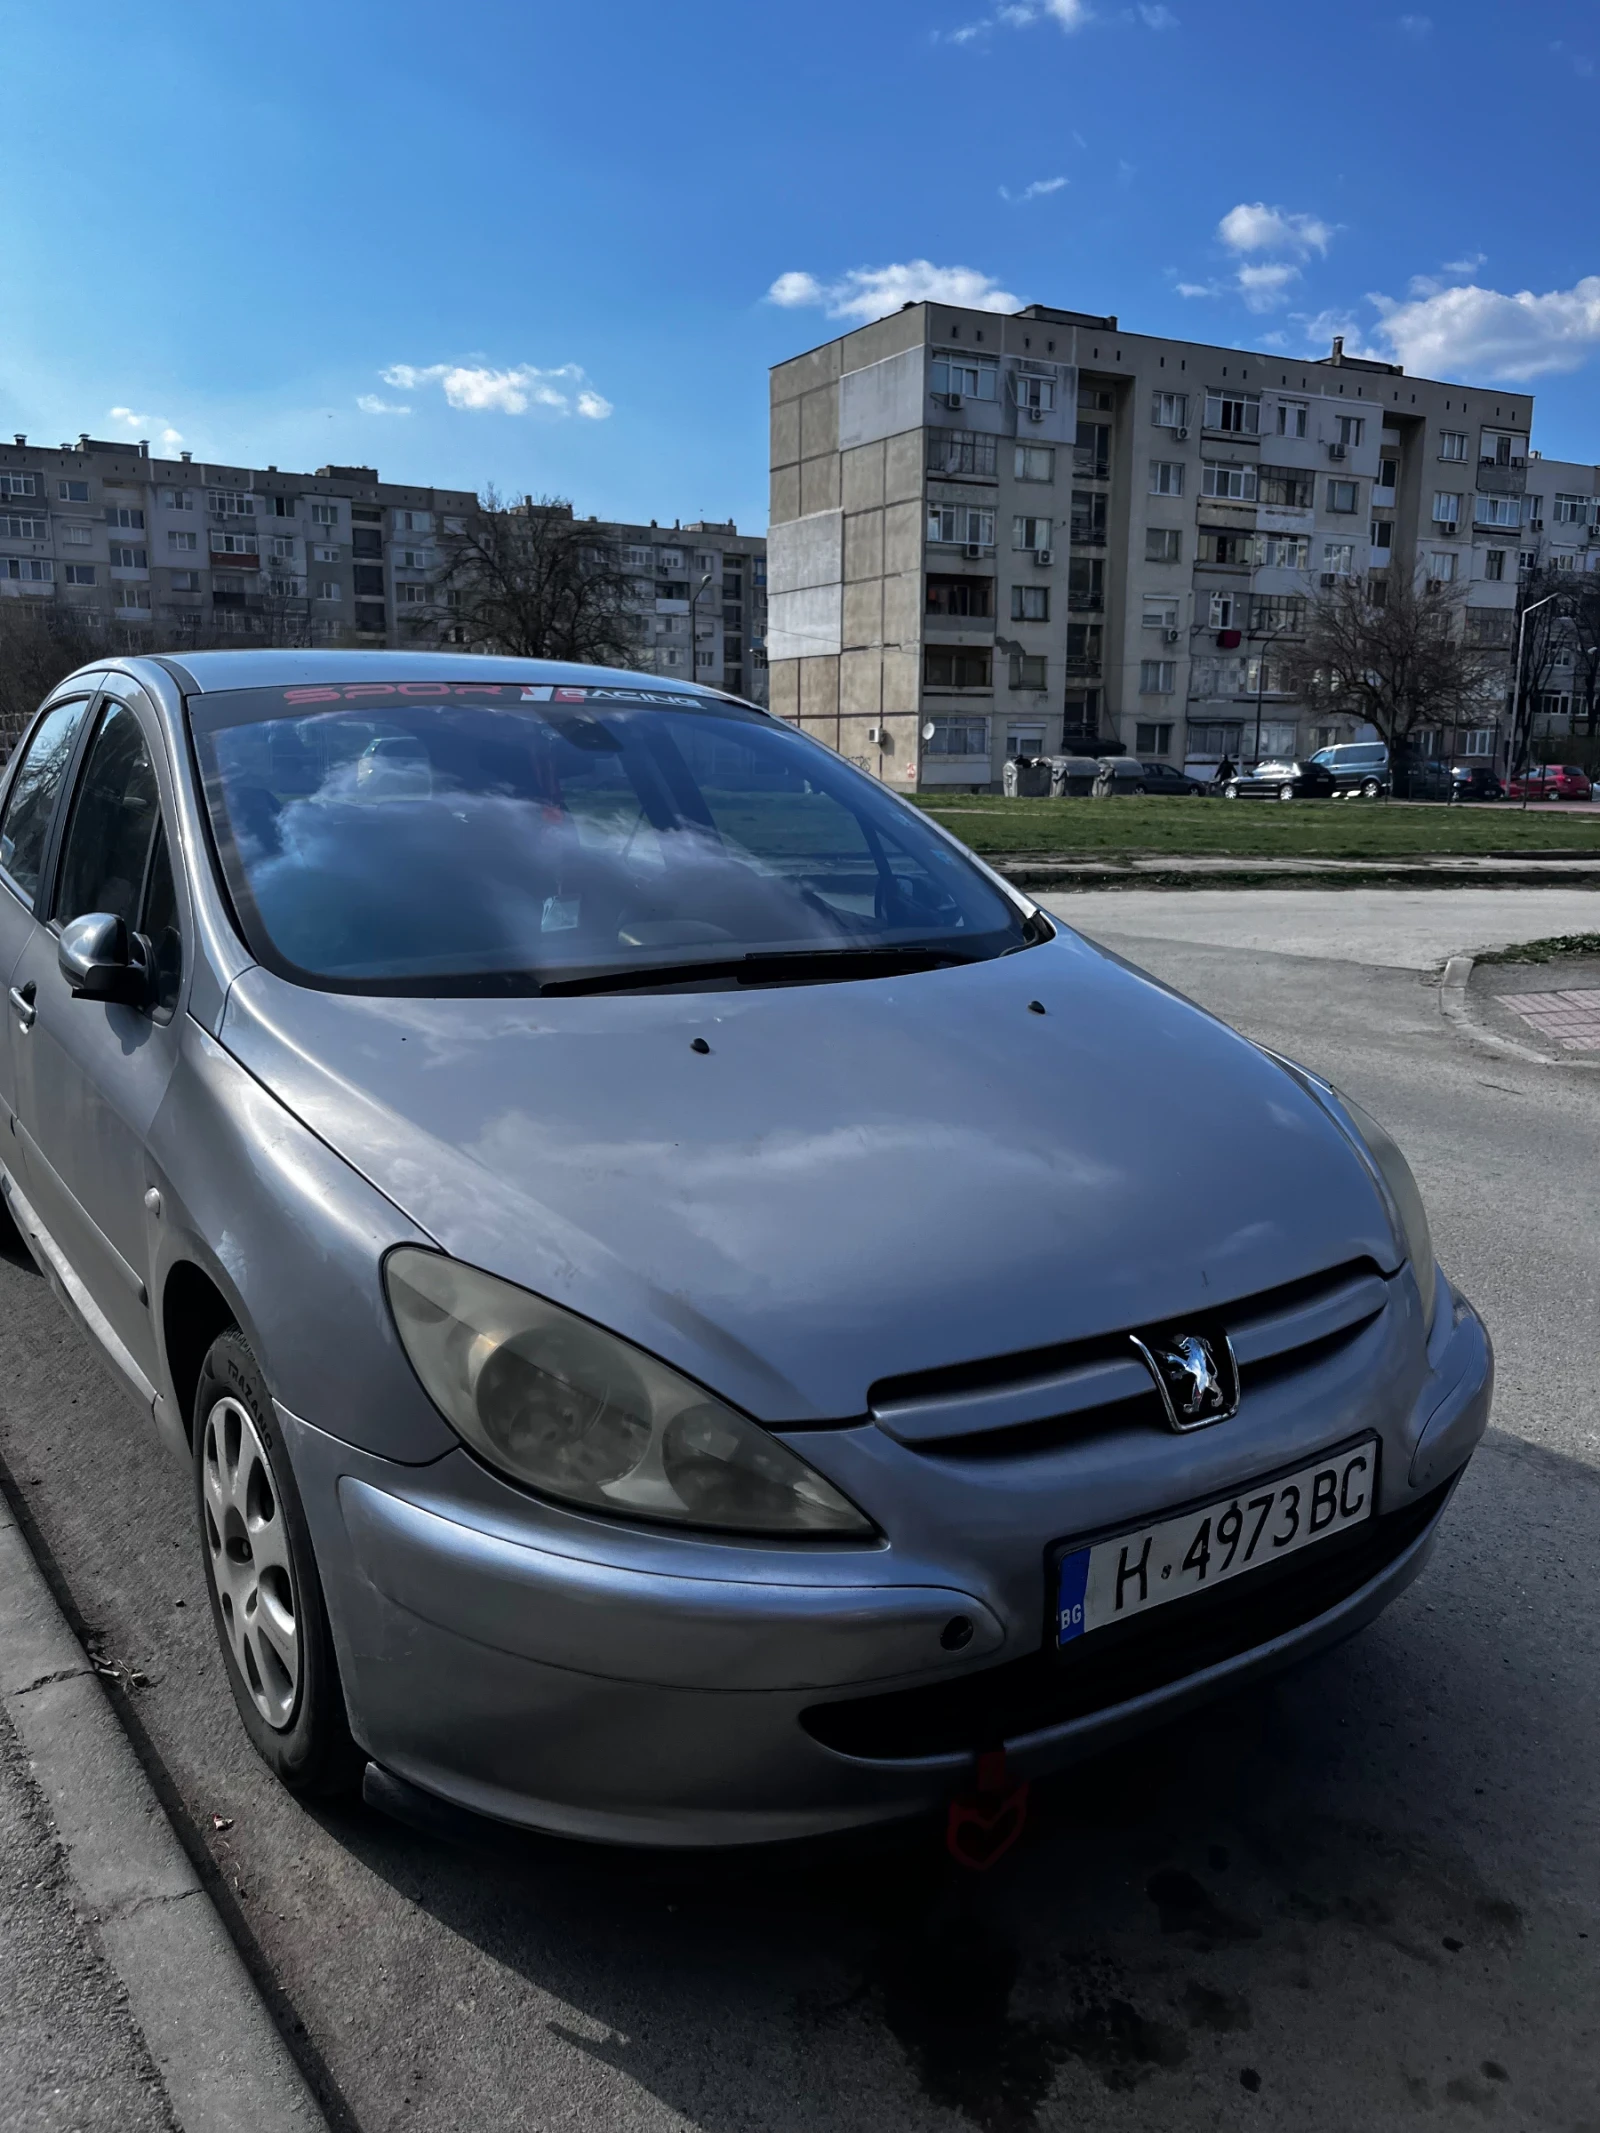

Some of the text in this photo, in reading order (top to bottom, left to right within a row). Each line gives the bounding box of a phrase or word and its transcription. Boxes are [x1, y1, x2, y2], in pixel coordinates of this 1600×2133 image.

[283, 682, 703, 708] SPORT RACING
[1060, 1604, 1082, 1630] BG
[1115, 1537, 1153, 1611] H
[1182, 1485, 1299, 1581] 4973
